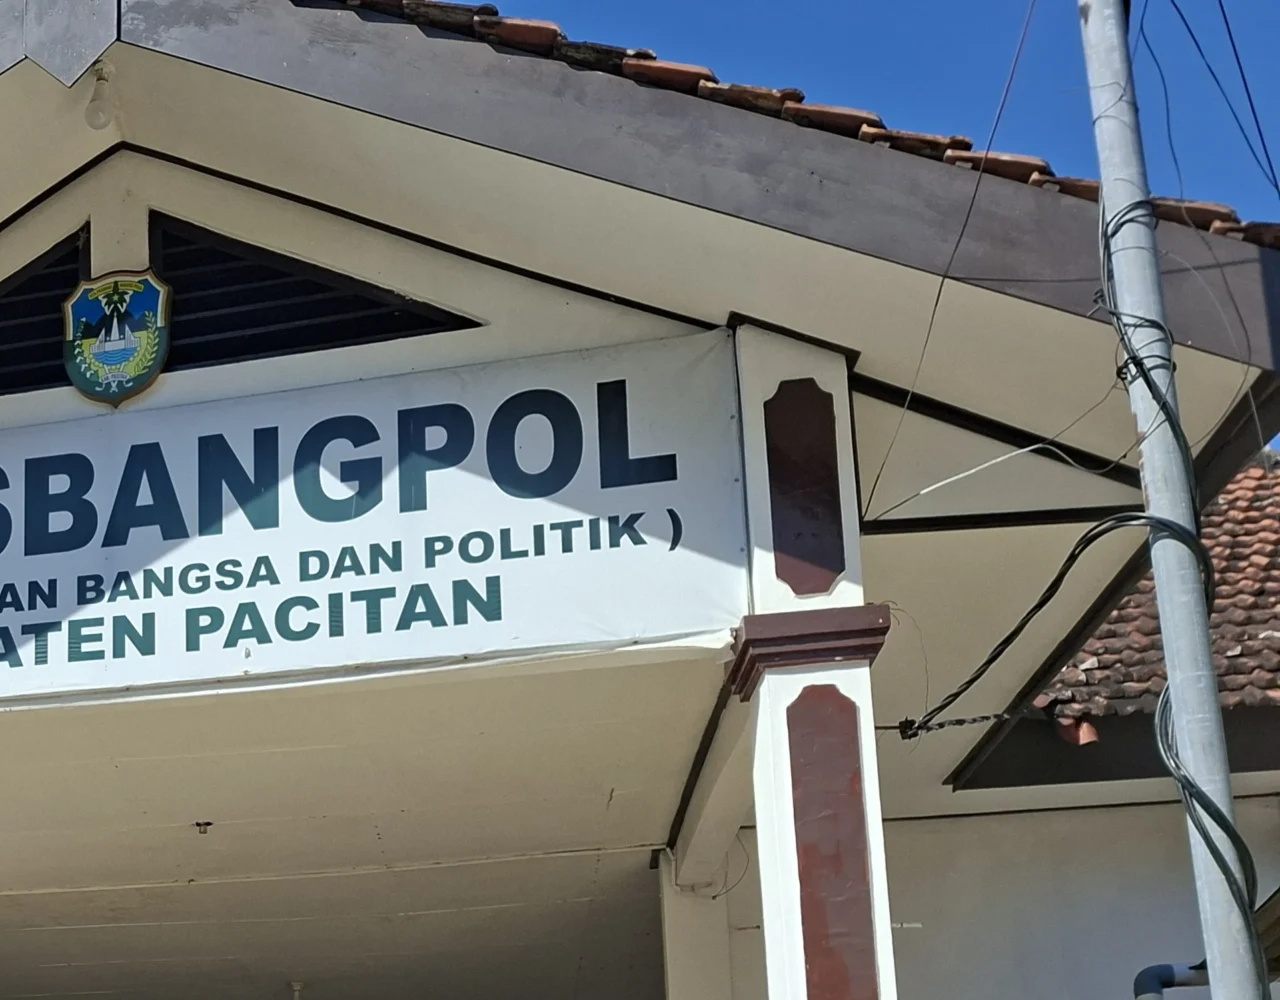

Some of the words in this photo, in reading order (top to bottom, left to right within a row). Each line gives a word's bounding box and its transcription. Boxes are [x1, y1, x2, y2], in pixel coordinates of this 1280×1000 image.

[76, 554, 281, 605] BANGSA
[299, 540, 403, 583] DAN
[424, 510, 648, 569] POLITIK
[185, 574, 503, 652] PACITAN
